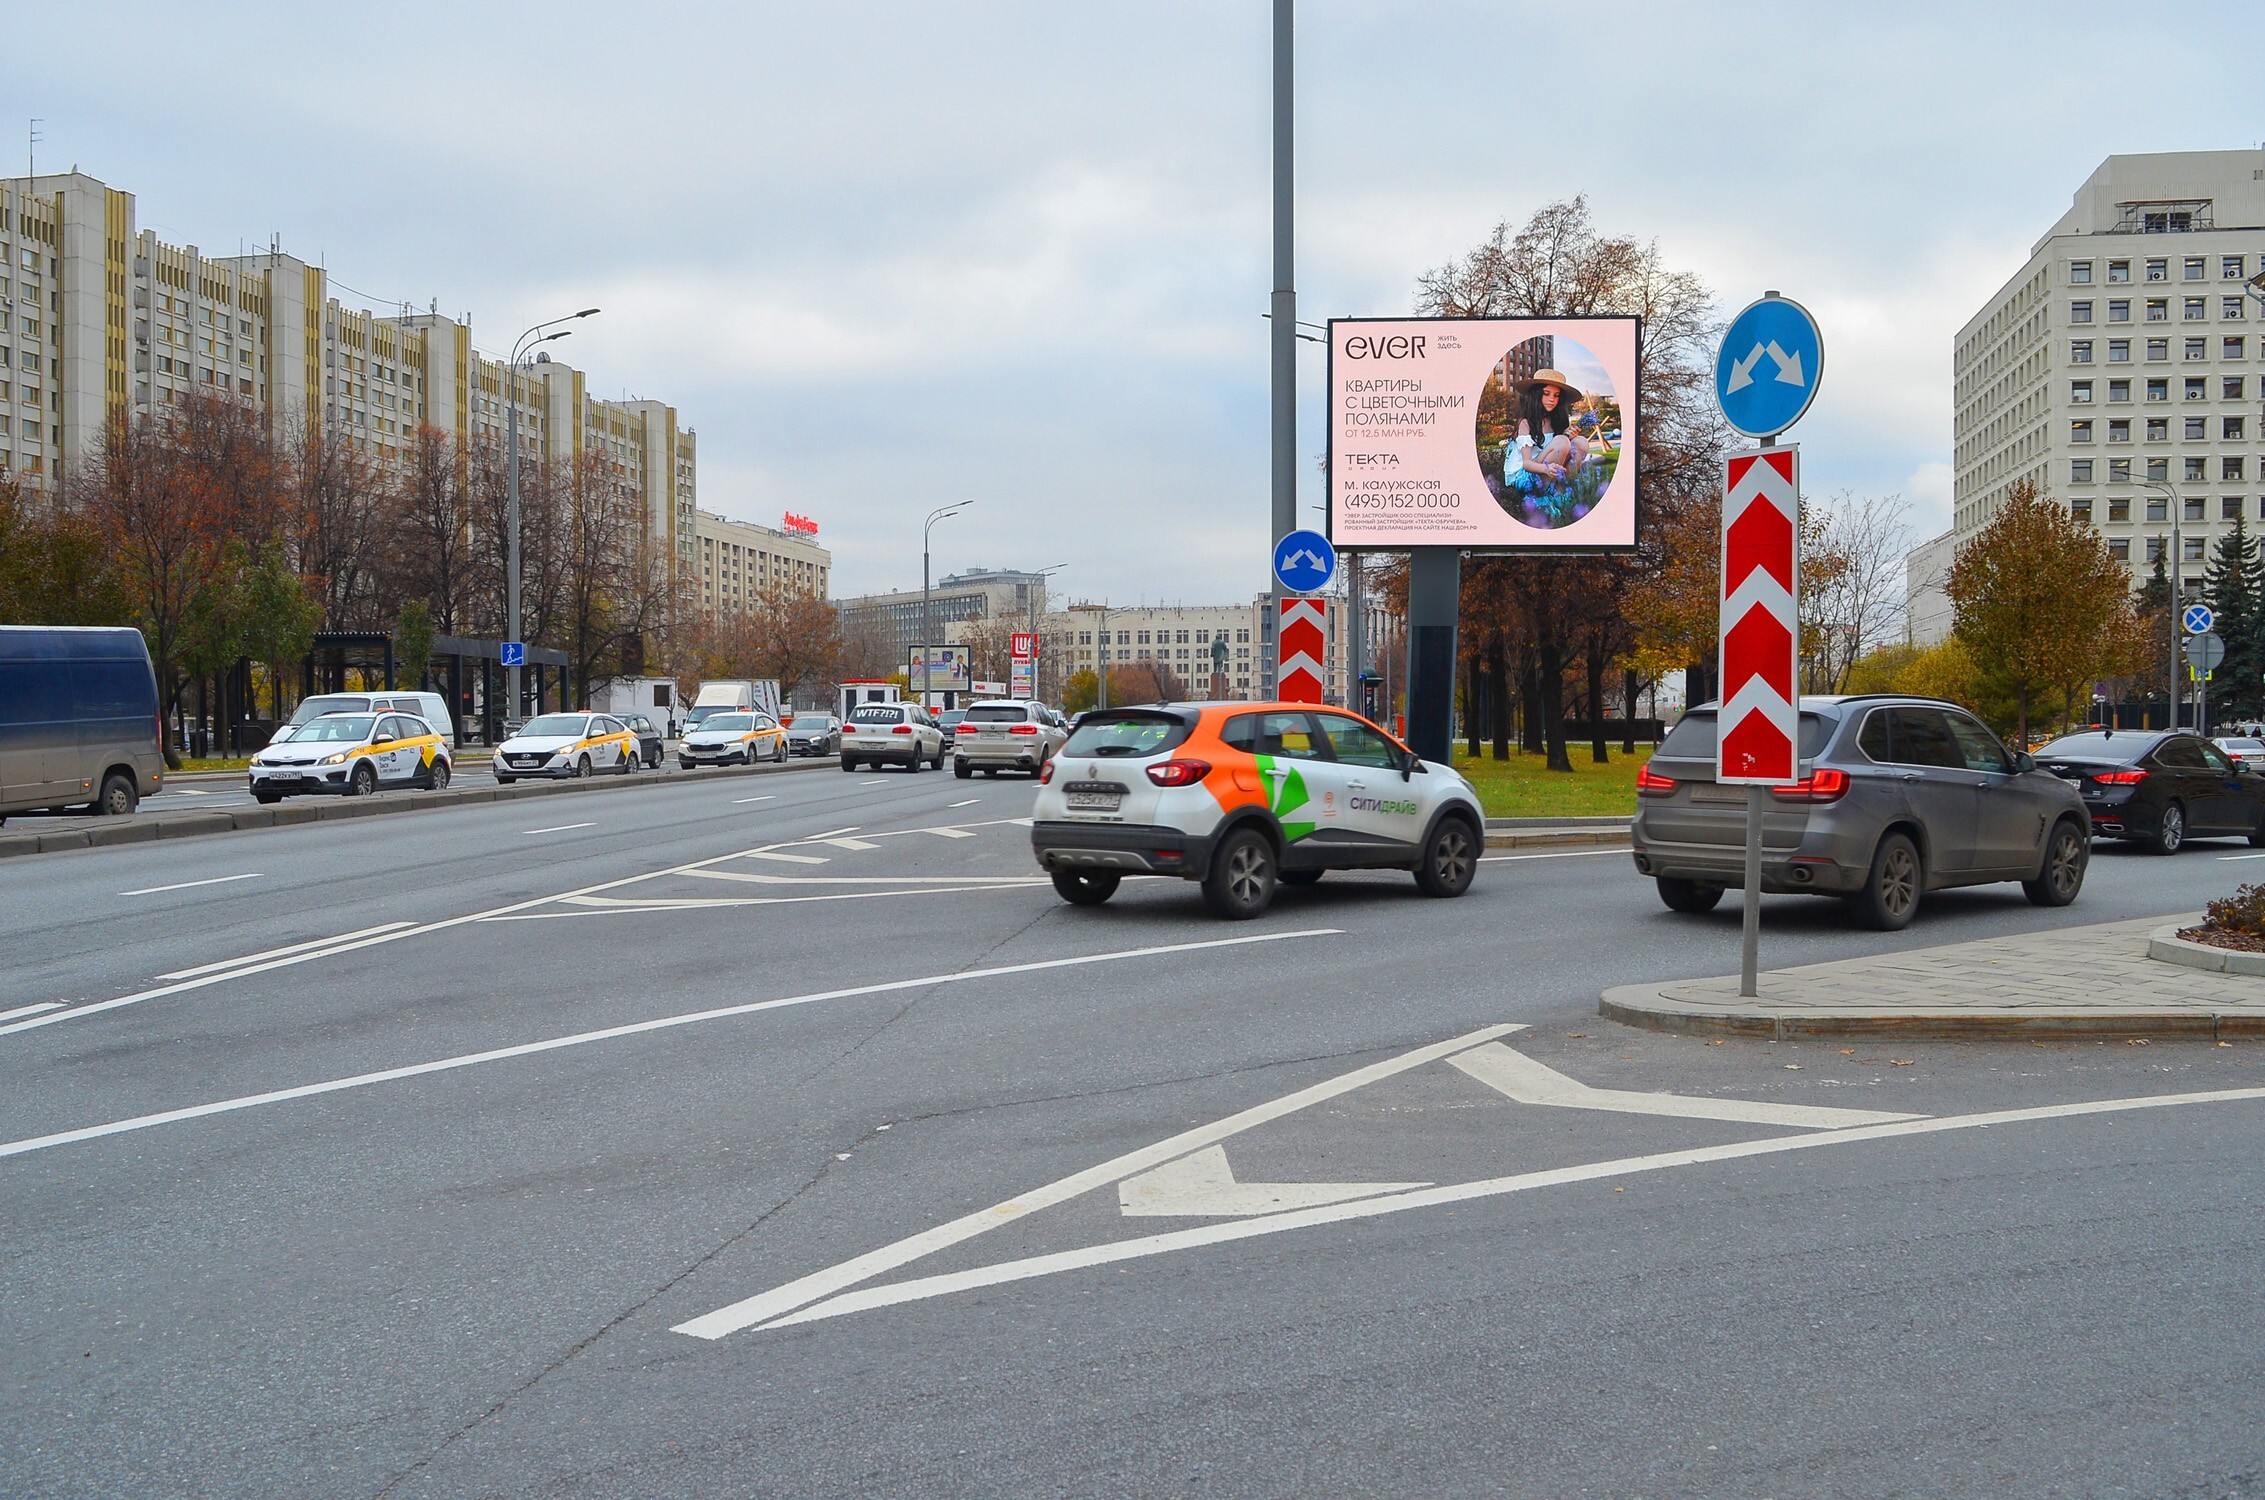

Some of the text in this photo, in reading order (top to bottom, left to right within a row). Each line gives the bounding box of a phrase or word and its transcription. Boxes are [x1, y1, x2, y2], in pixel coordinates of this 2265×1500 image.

[1345, 380, 1421, 392] КВАРТИРЫ
[1345, 396, 1464, 410] С ЦВЕТОЧНЫМИ
[1345, 412, 1435, 425] ПОЛЯНАМИ
[1345, 429, 1426, 438] ОТ 12,5 МЛН РУБ.
[1345, 454, 1400, 464] ТЕКТА
[856, 709, 898, 719] WTF?!?!
